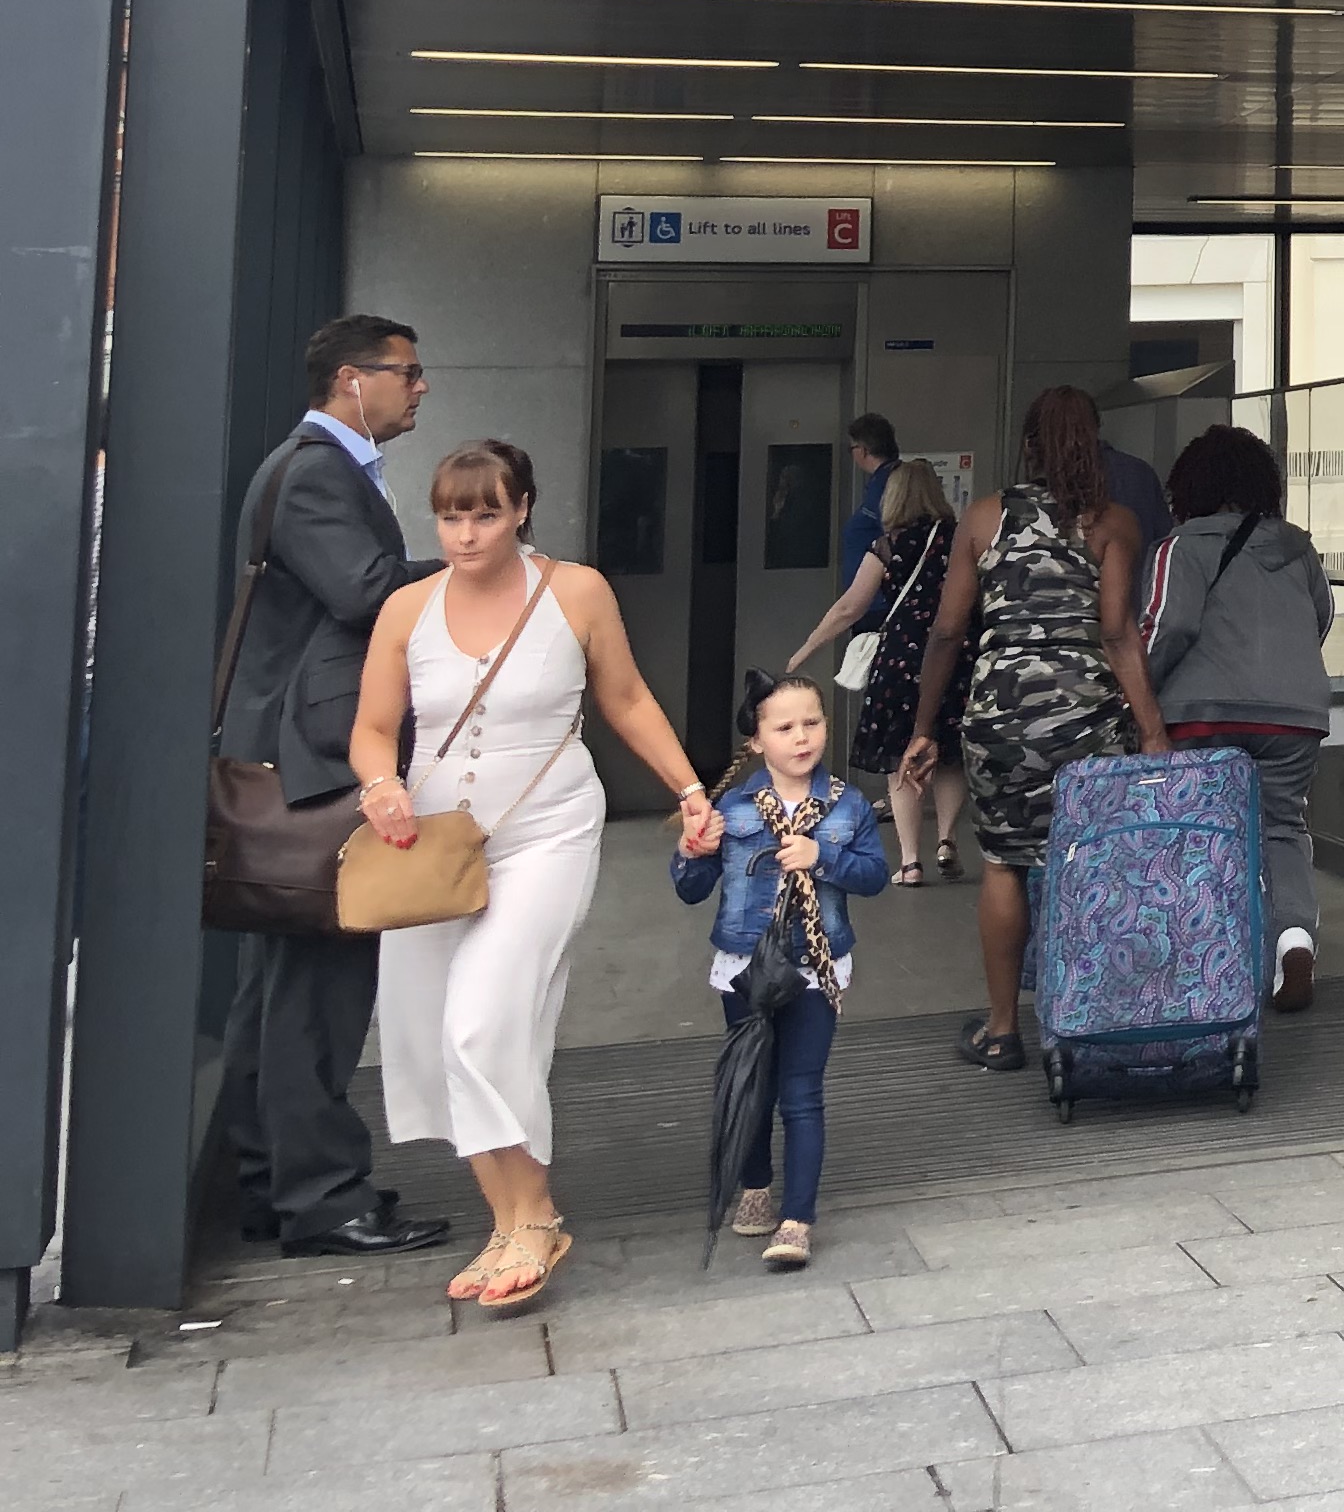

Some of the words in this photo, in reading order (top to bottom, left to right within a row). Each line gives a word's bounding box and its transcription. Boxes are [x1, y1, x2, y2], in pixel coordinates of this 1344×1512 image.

[835, 212, 852, 221] Lift
[688, 221, 718, 236] Lift
[724, 222, 743, 235] to
[747, 221, 767, 236] all
[773, 222, 811, 236] lines
[833, 223, 853, 244] C
